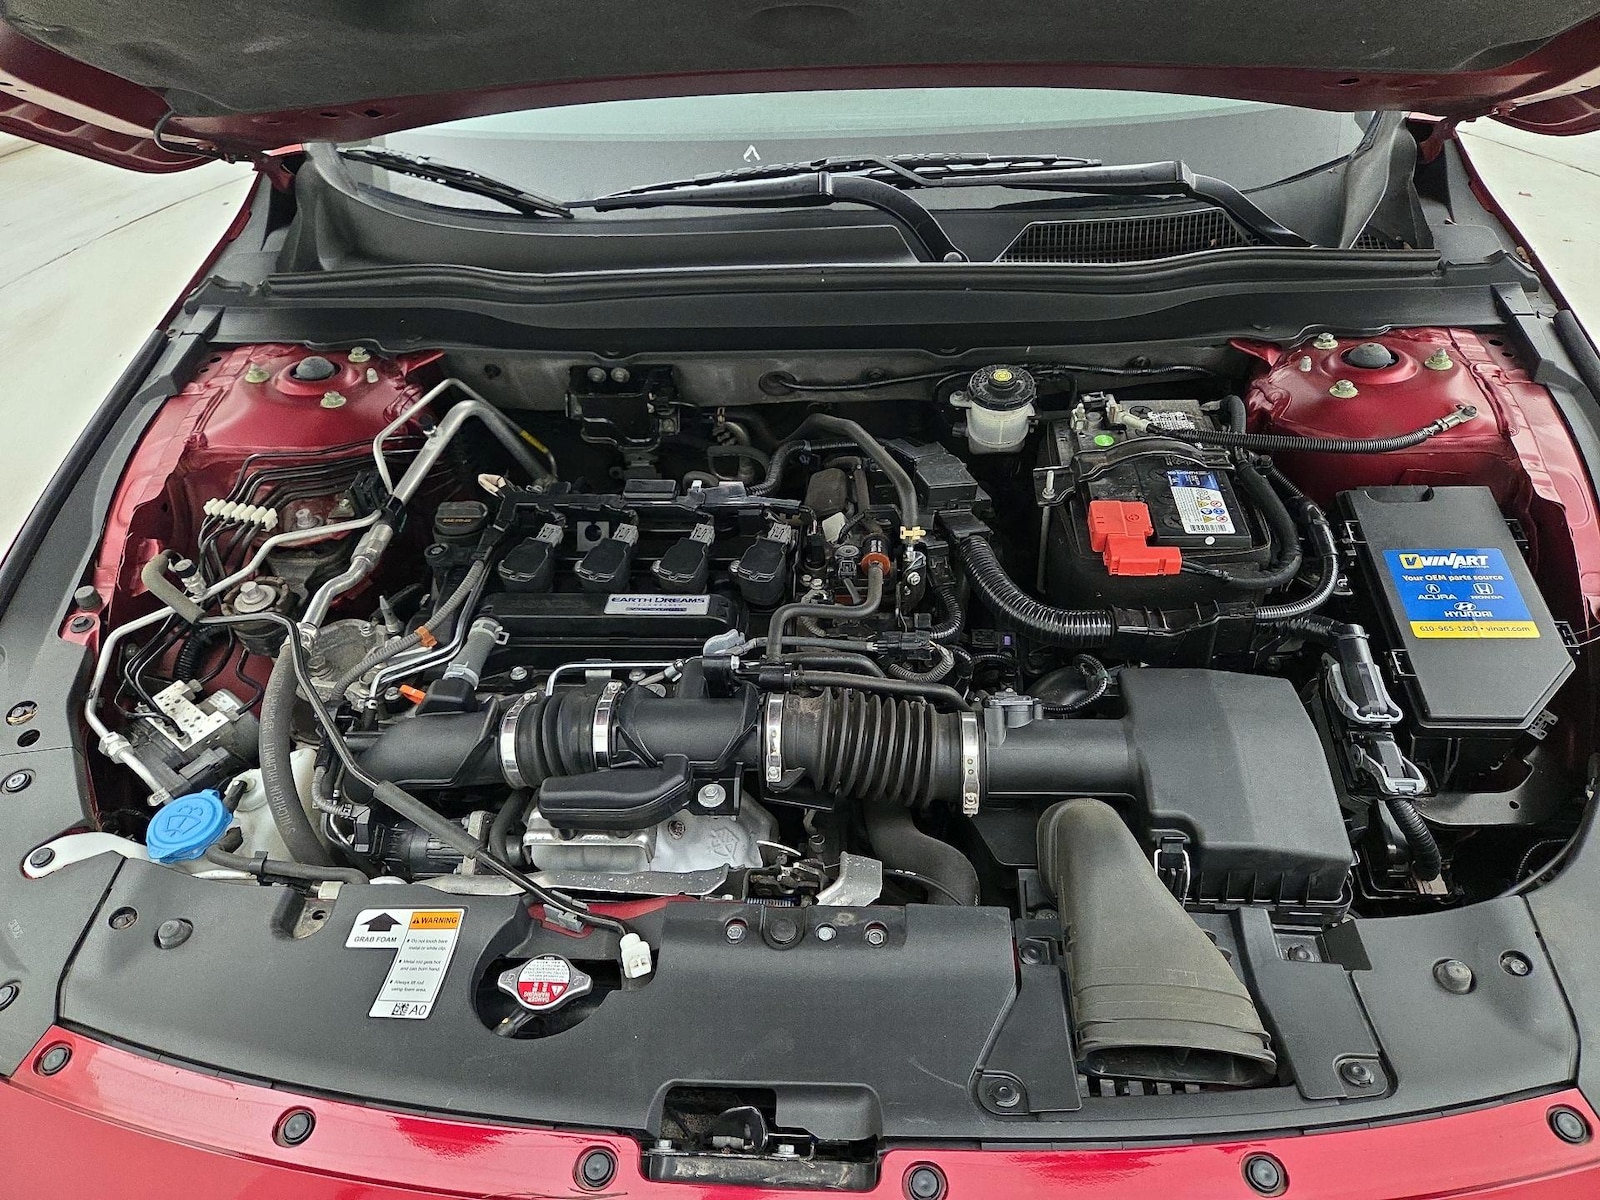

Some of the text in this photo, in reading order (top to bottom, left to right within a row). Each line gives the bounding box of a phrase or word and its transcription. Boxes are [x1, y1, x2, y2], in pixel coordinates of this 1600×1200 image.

[1420, 553, 1489, 569] VINART
[1448, 574, 1472, 582] parts
[408, 1004, 428, 1016] A0
